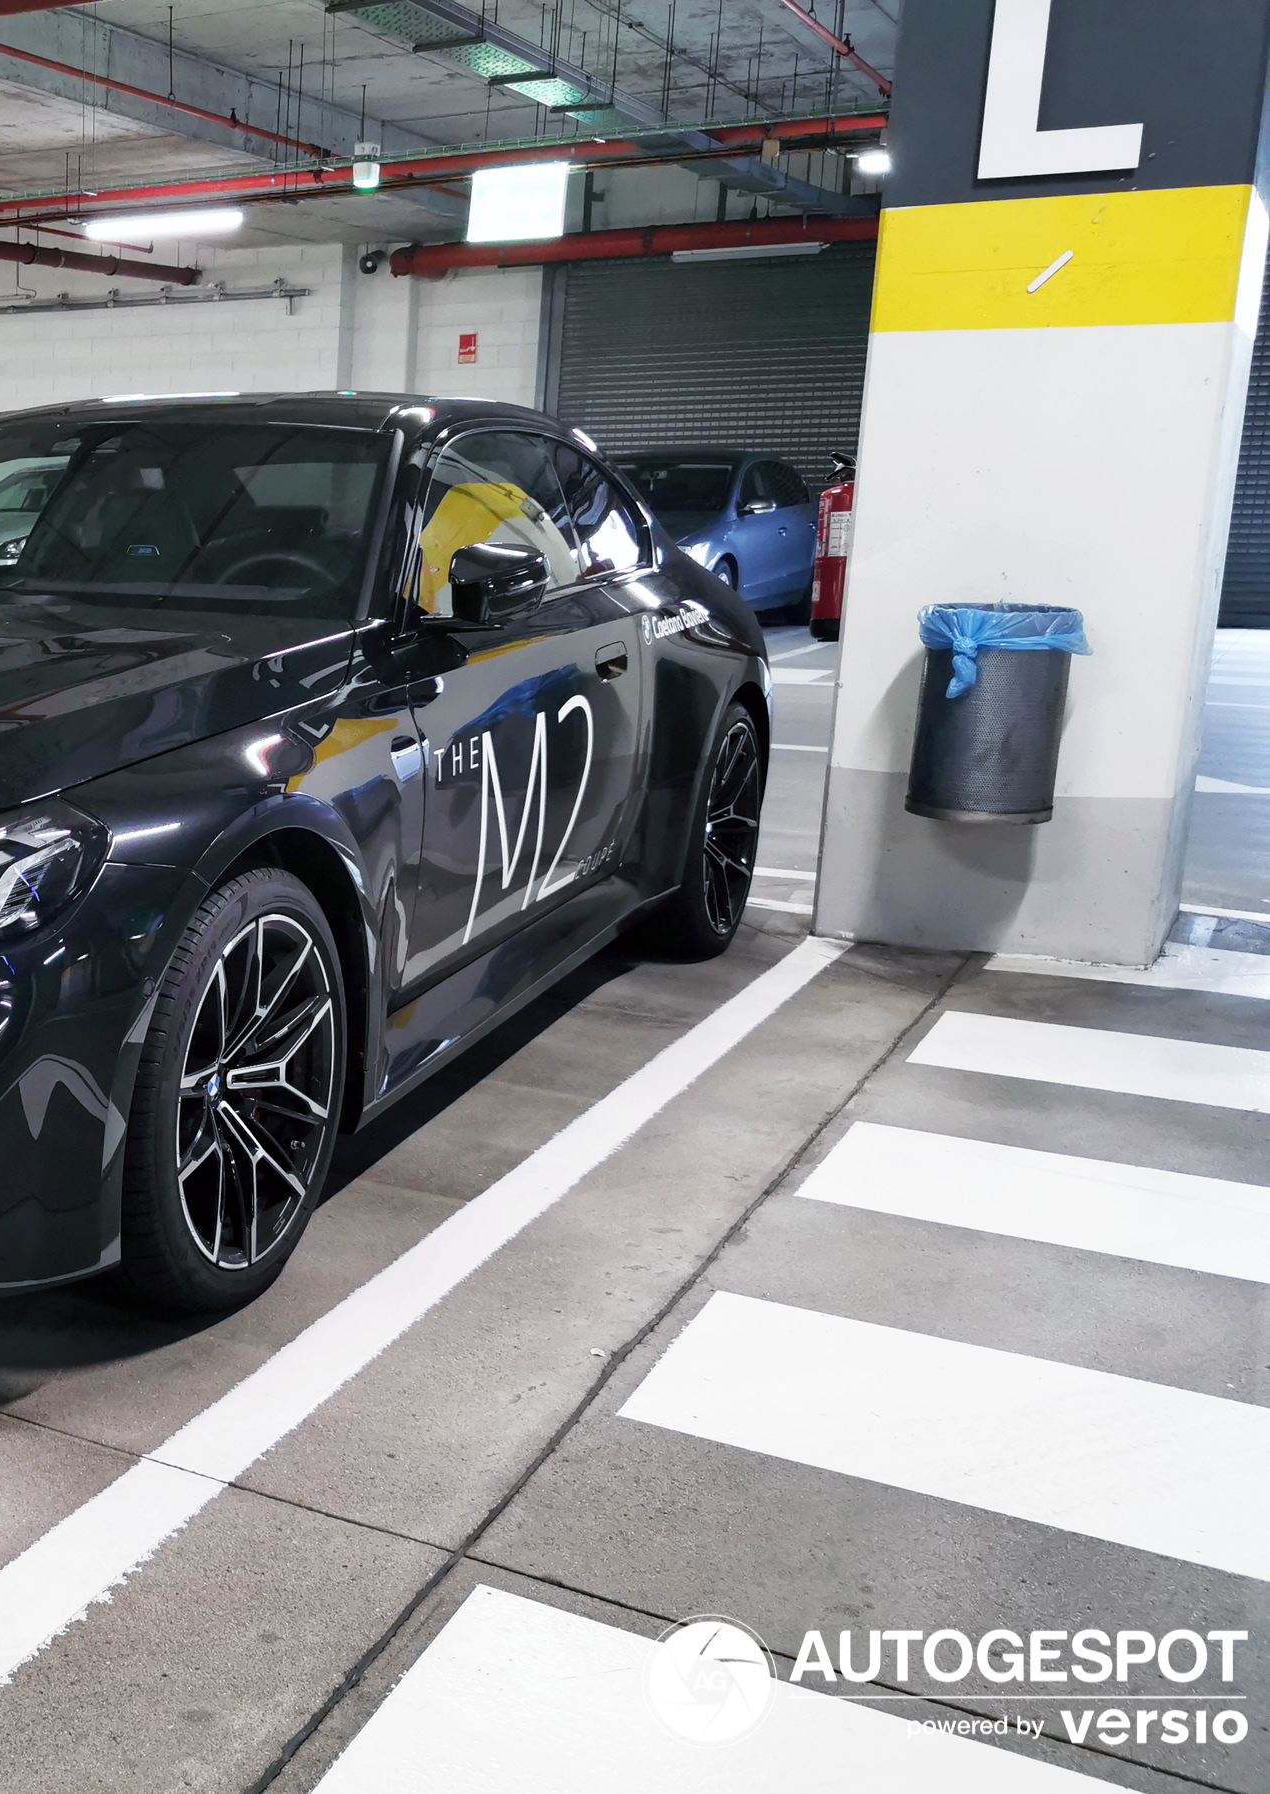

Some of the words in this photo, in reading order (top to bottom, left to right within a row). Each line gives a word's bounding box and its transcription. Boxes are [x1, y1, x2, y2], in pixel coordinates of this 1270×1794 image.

[977, 0, 1144, 179] L
[651, 615, 685, 639] Caetano
[434, 736, 479, 782] THE
[462, 694, 594, 945] M2
